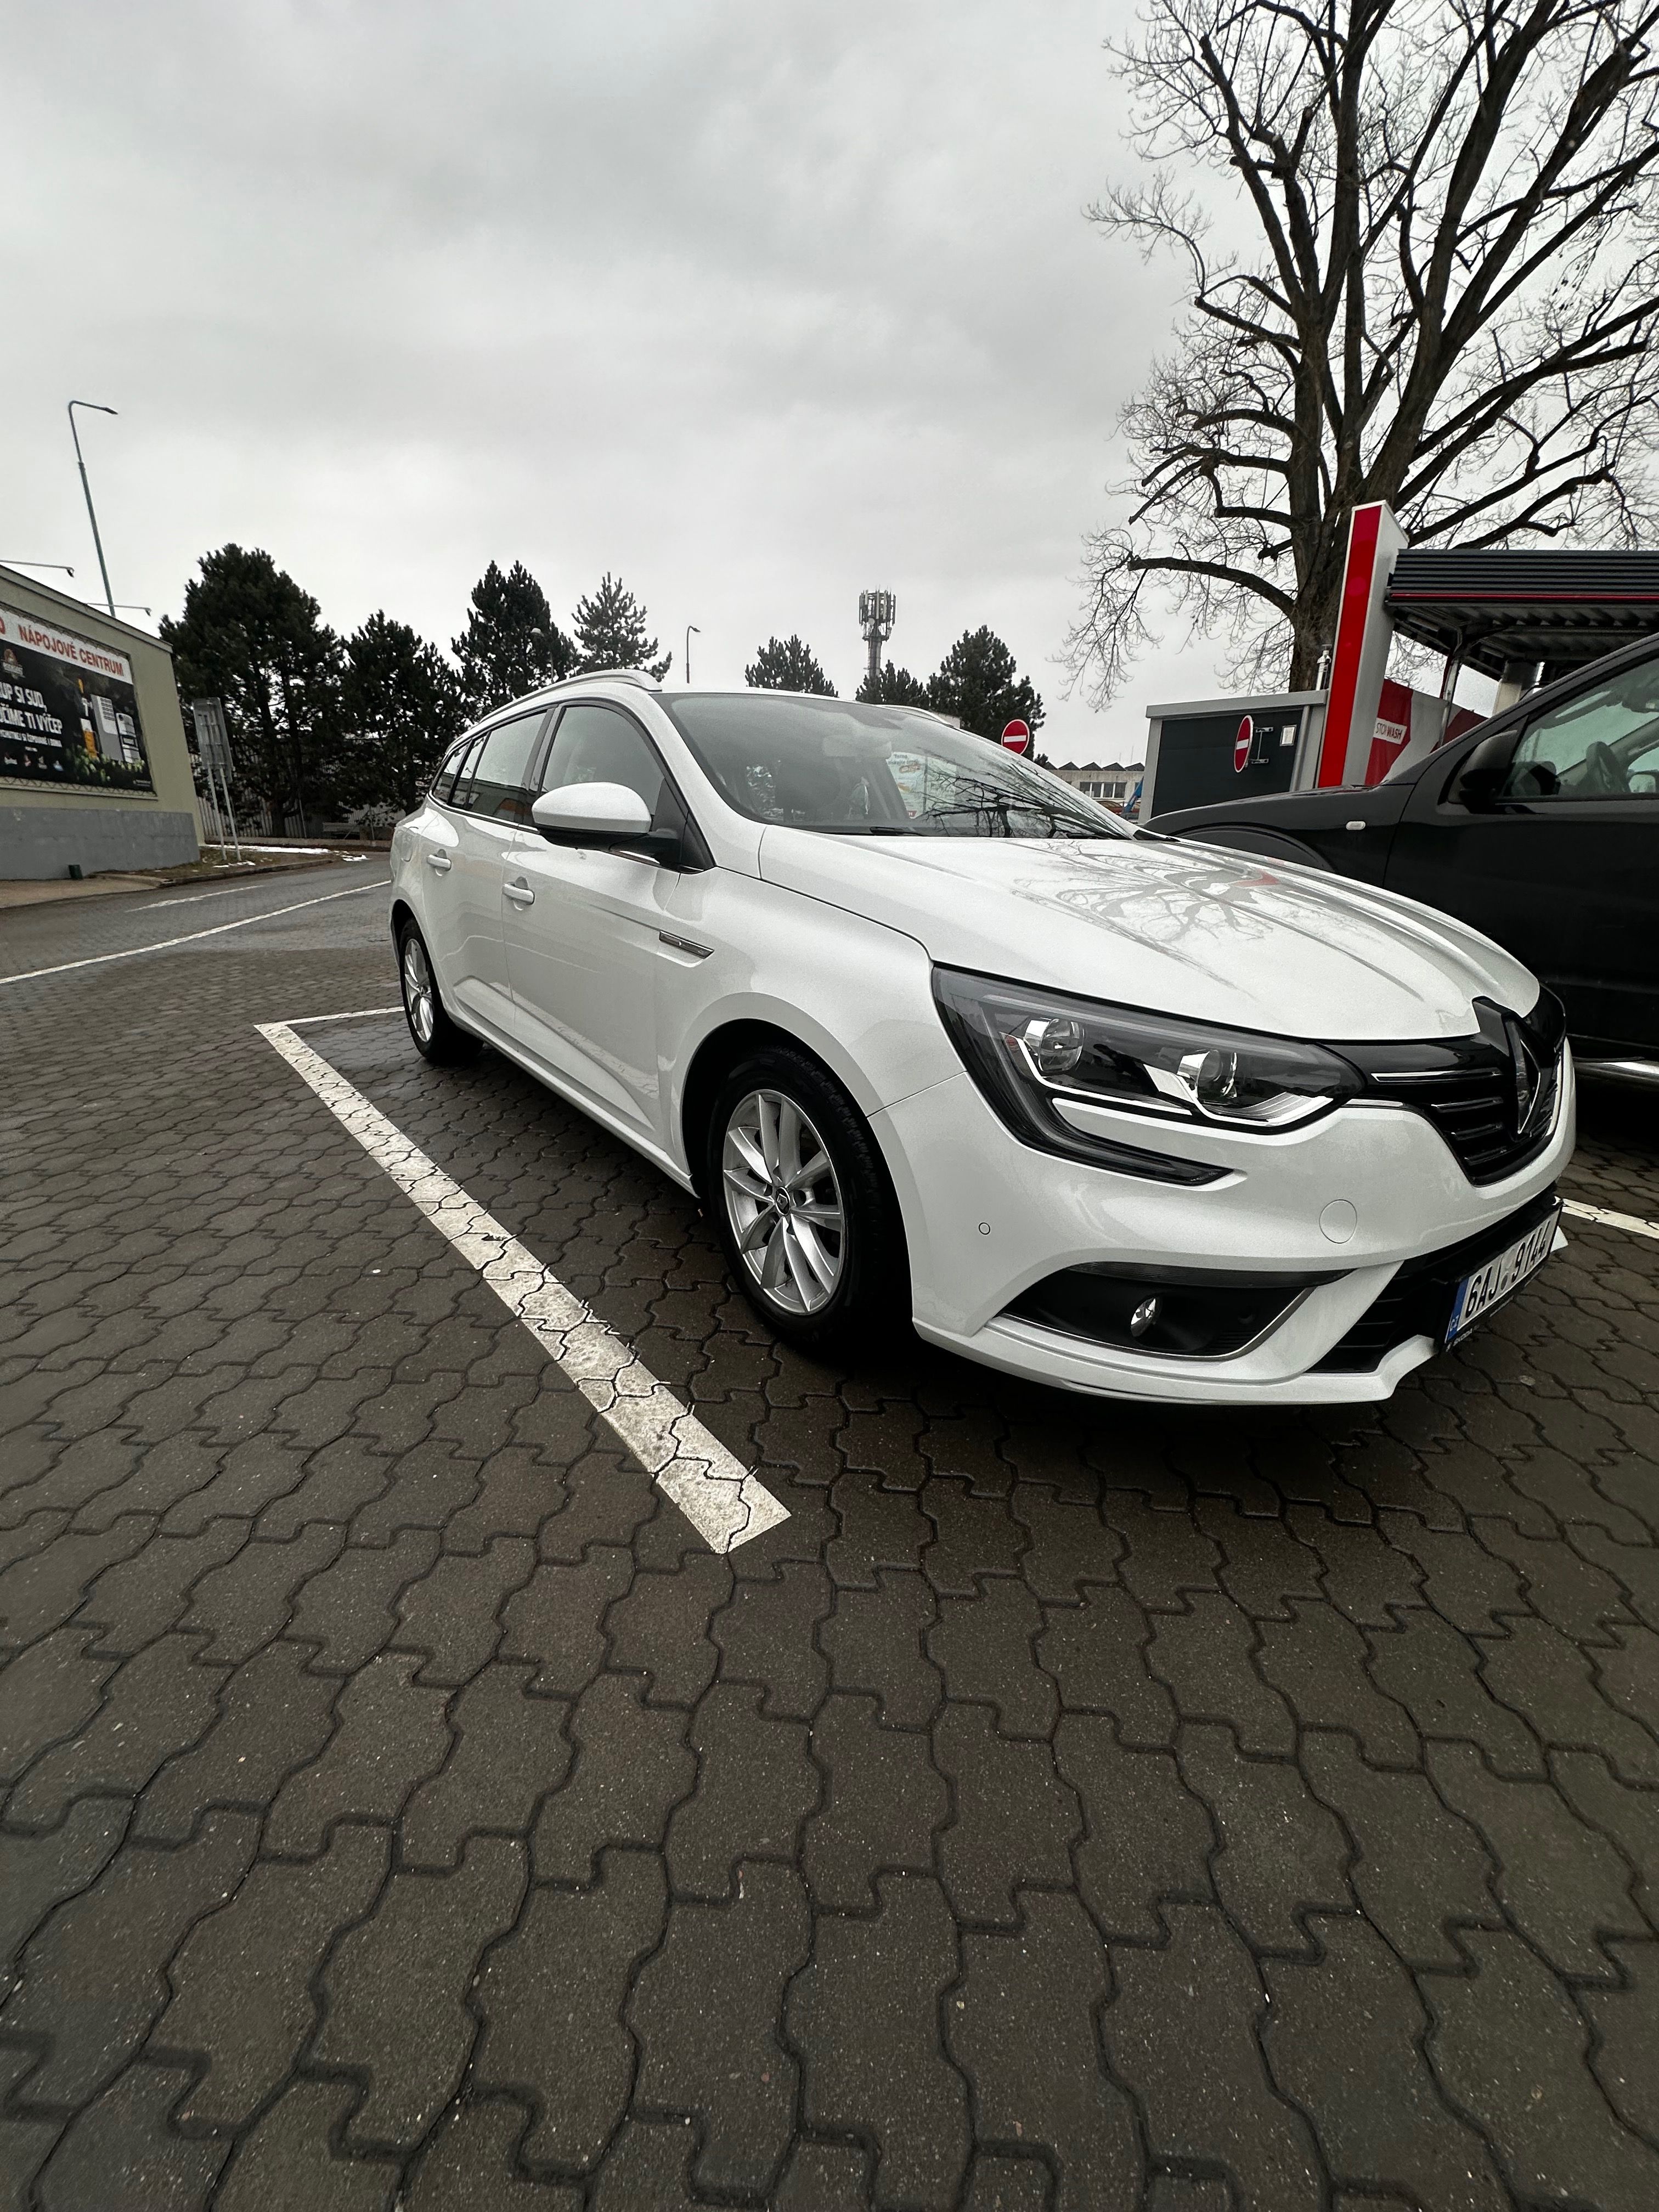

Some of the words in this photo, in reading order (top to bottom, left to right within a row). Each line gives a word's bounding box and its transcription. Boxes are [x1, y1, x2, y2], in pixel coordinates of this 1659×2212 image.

[18, 624, 77, 660] NÁPOJOVÉ
[79, 649, 124, 676] CENTRUM
[1466, 1260, 1502, 1318] 6AJ
